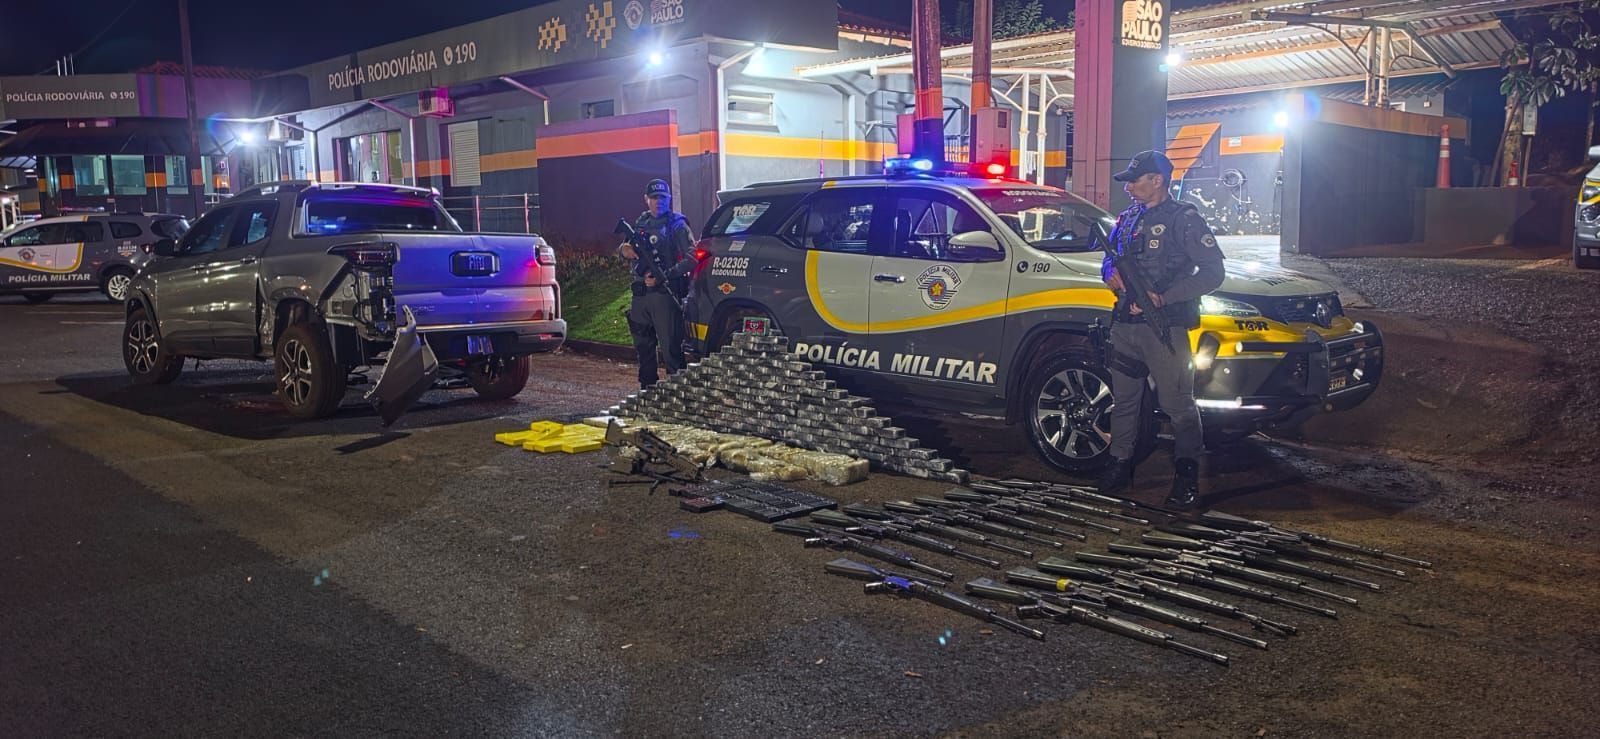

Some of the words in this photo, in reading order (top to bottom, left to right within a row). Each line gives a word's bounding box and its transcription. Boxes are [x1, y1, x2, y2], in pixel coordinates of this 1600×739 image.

[651, 5, 684, 24] PAULO
[1122, 20, 1162, 42] PAULO
[328, 65, 365, 91] POLÍCIA
[367, 50, 438, 83] RODOVIÁRIA
[456, 41, 477, 64] 190
[6, 91, 44, 103] POLÍCIA
[45, 89, 105, 102] RODOVIÁRIA
[119, 91, 135, 99] 190
[713, 257, 750, 269] R-02305
[1032, 262, 1051, 273] 190
[8, 273, 48, 283] POLÍCIA
[50, 273, 91, 283] MILITAR
[711, 268, 747, 277] RODOVIÁRIA
[1234, 319, 1269, 331] TOR
[795, 341, 880, 370] POLÍCIA
[890, 353, 997, 384] MILITAR
